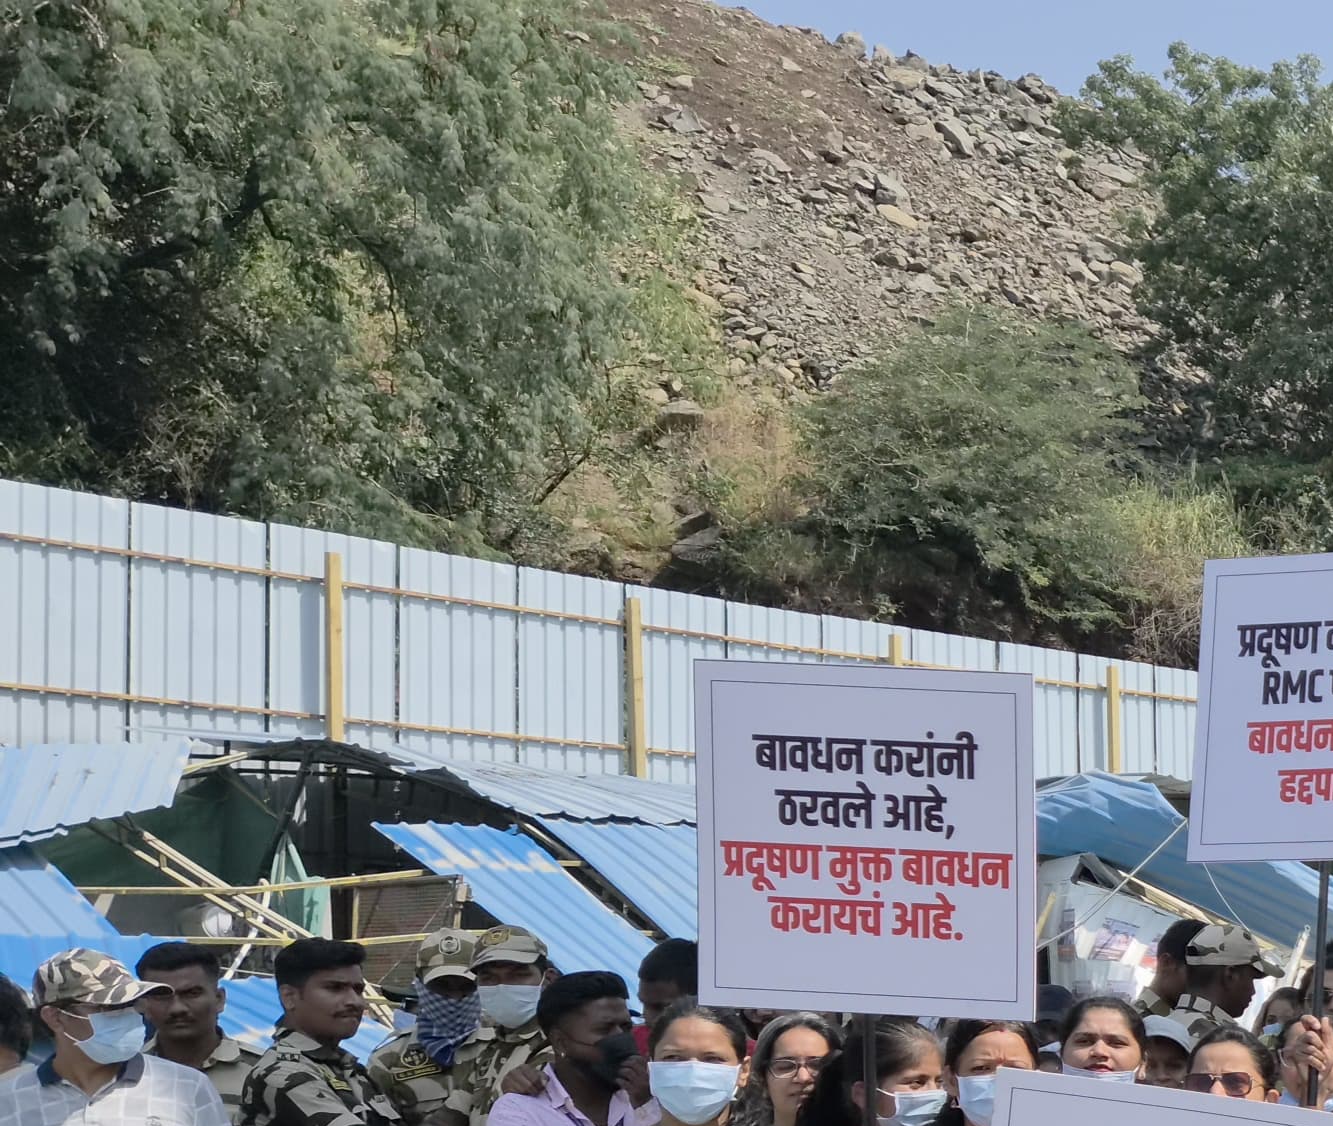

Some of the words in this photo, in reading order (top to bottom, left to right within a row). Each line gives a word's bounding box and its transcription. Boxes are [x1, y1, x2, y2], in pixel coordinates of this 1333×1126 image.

[1237, 620, 1323, 669] प्रदूषण
[1261, 668, 1325, 705] RMC
[751, 733, 868, 775] बावधन
[869, 731, 979, 780] करांनी
[774, 780, 877, 830] ठरवले
[883, 783, 955, 840] आहे,
[719, 840, 824, 892] प्रदूषण
[825, 845, 897, 896] मुक्त
[898, 848, 1014, 890] बावधन
[767, 890, 885, 937] करायचं
[891, 891, 964, 941] आहे.
